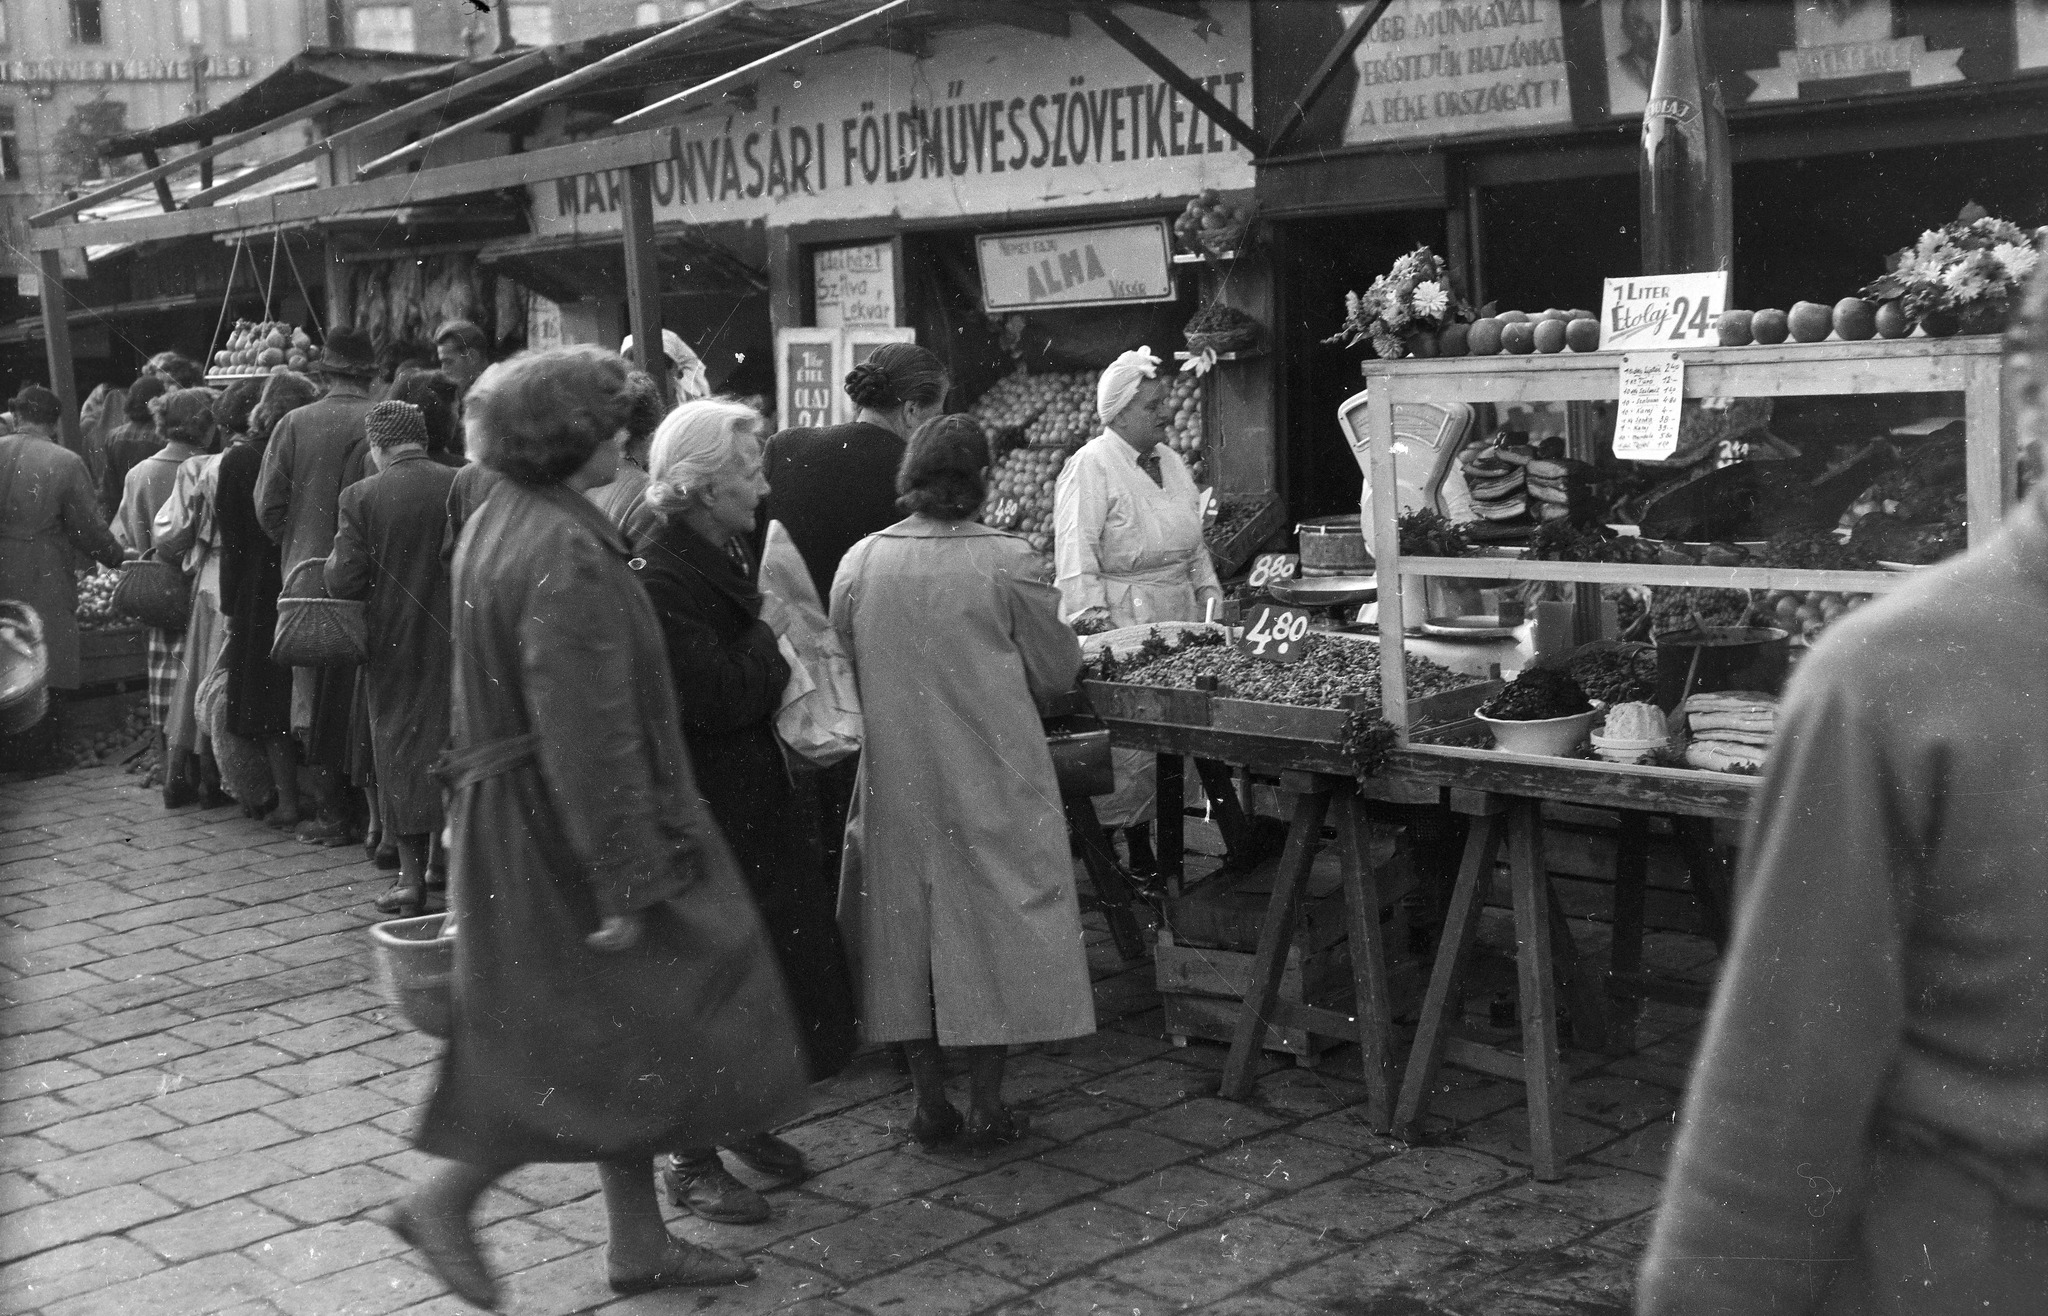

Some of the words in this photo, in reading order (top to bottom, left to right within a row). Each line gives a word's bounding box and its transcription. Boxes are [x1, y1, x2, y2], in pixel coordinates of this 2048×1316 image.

[1027, 244, 1105, 300] ALMA
[1614, 285, 1623, 300] 1
[1612, 301, 1671, 336] Étolaj
